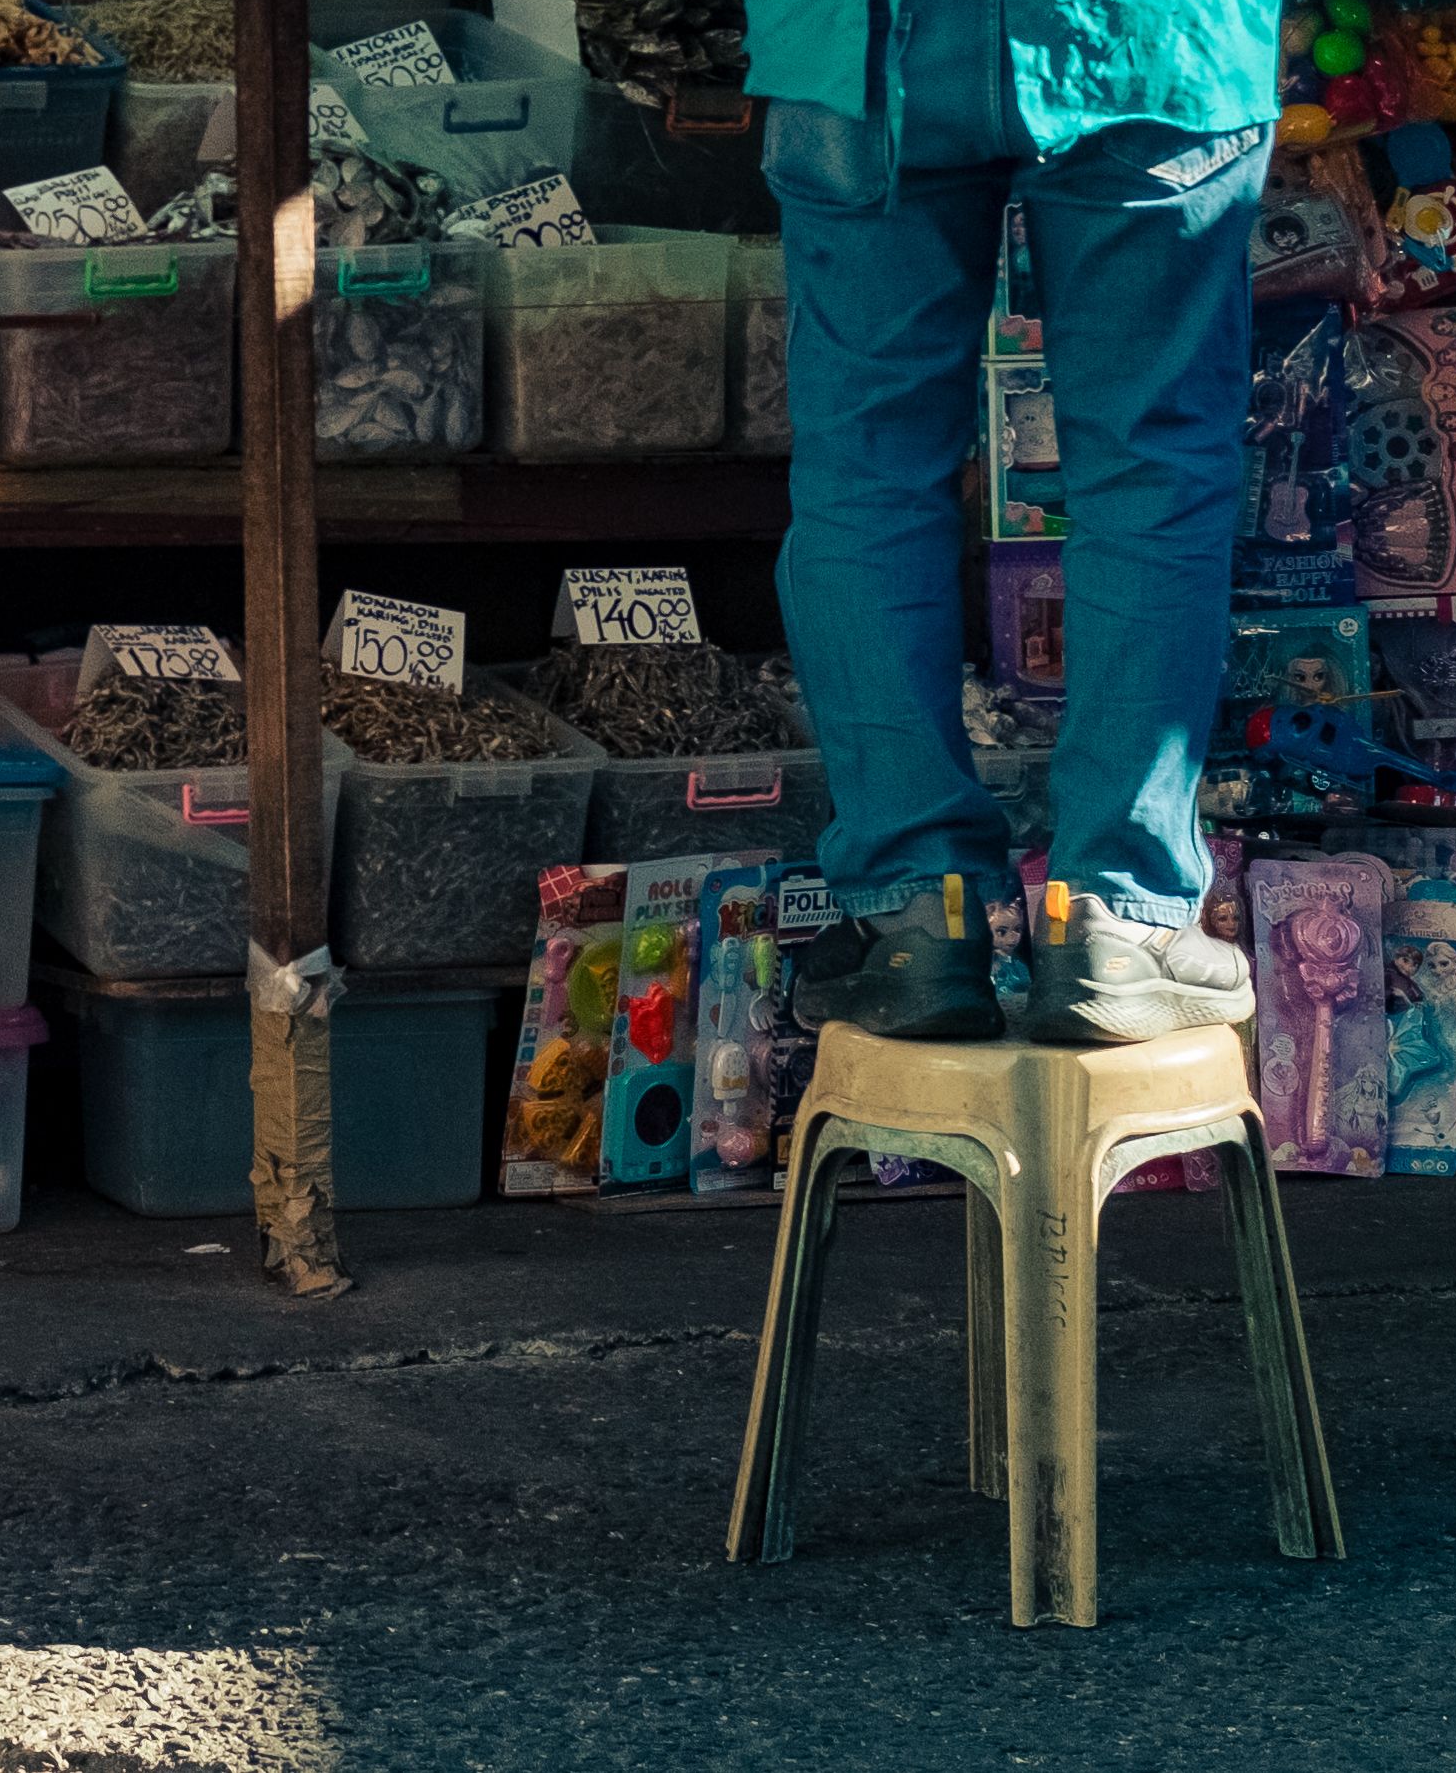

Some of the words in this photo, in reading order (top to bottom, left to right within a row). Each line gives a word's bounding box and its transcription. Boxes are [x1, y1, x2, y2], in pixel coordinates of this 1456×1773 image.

[1262, 553, 1344, 573] FASHION
[579, 585, 622, 598] DILIS
[1280, 586, 1331, 603] DOLL
[648, 877, 693, 901] ROLE
[635, 902, 673, 922] PLAY
